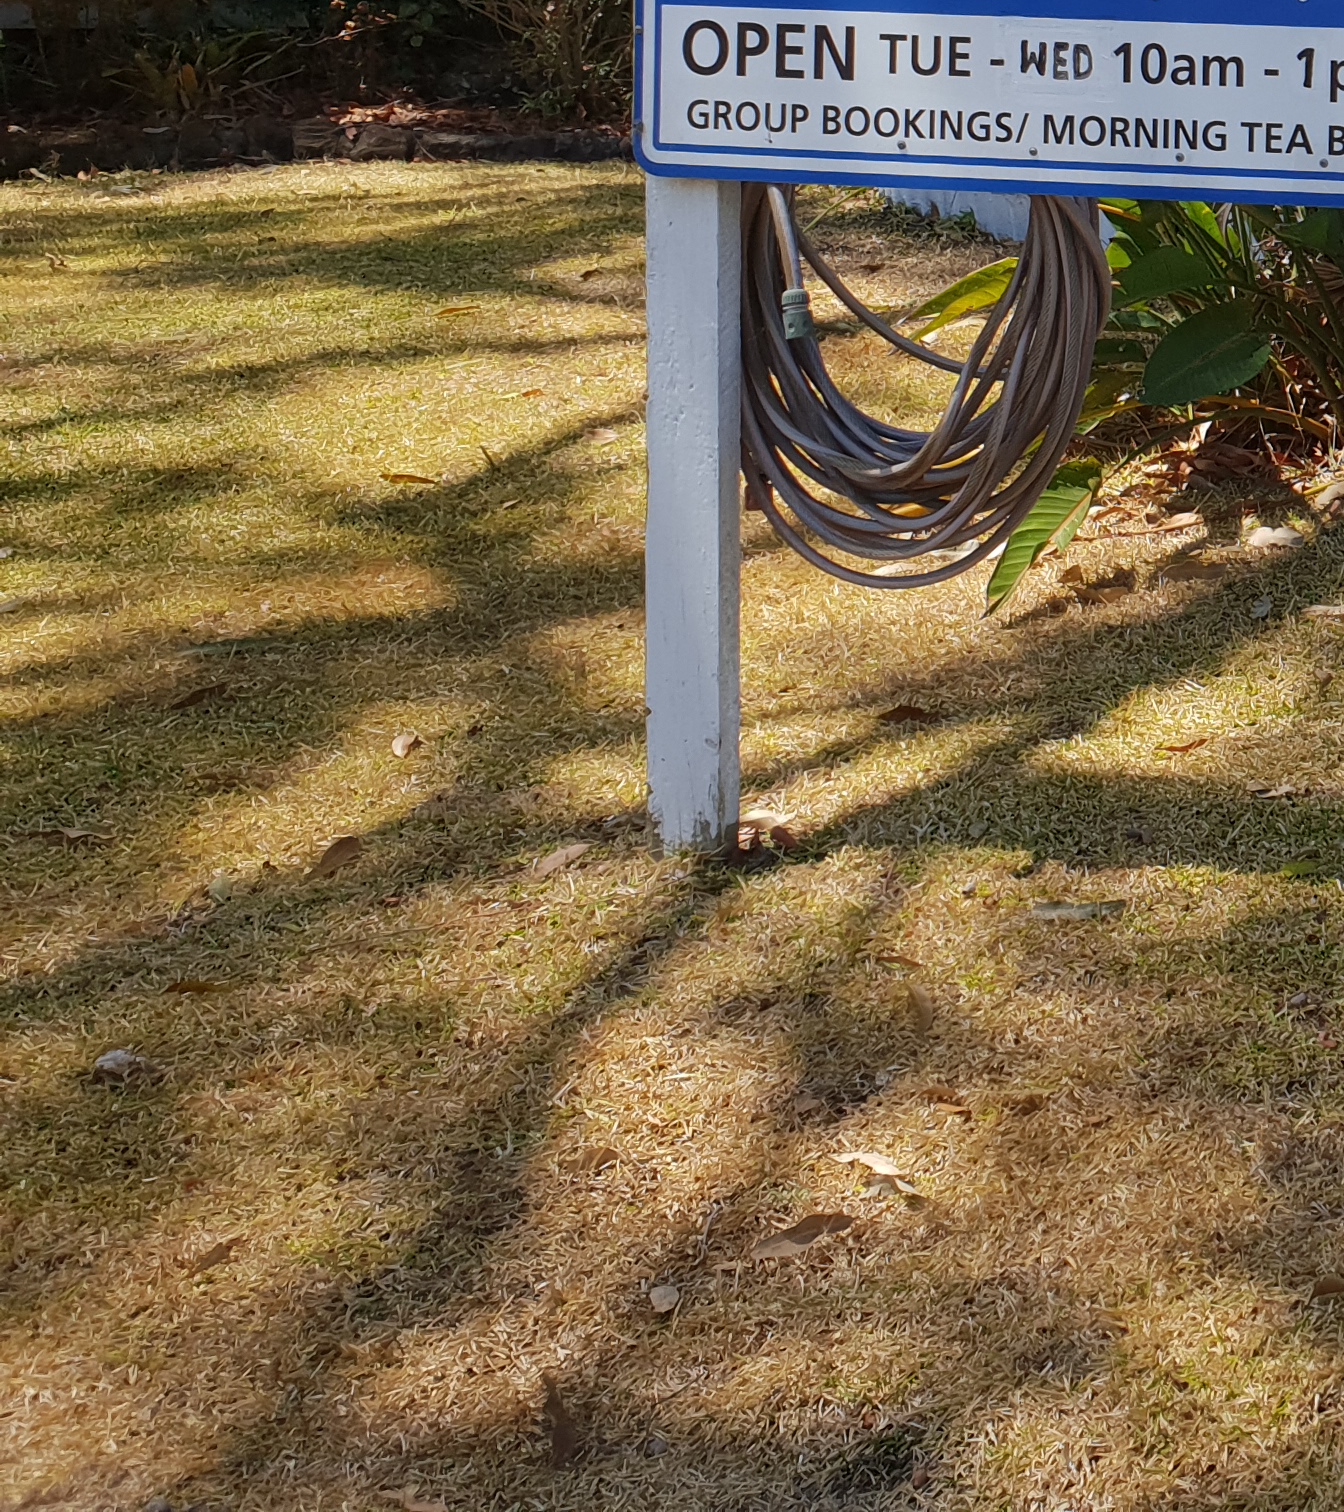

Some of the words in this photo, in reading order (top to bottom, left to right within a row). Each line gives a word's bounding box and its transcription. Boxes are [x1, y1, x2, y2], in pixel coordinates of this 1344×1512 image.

[681, 19, 857, 81] OPEN
[879, 33, 972, 77] TUE
[1020, 39, 1093, 80] WED
[1112, 42, 1245, 87] 10am
[686, 99, 810, 134] GROUP
[822, 104, 1030, 144] BOOKINGS/
[1043, 115, 1227, 153] MORNING
[1241, 122, 1314, 156] TEA
